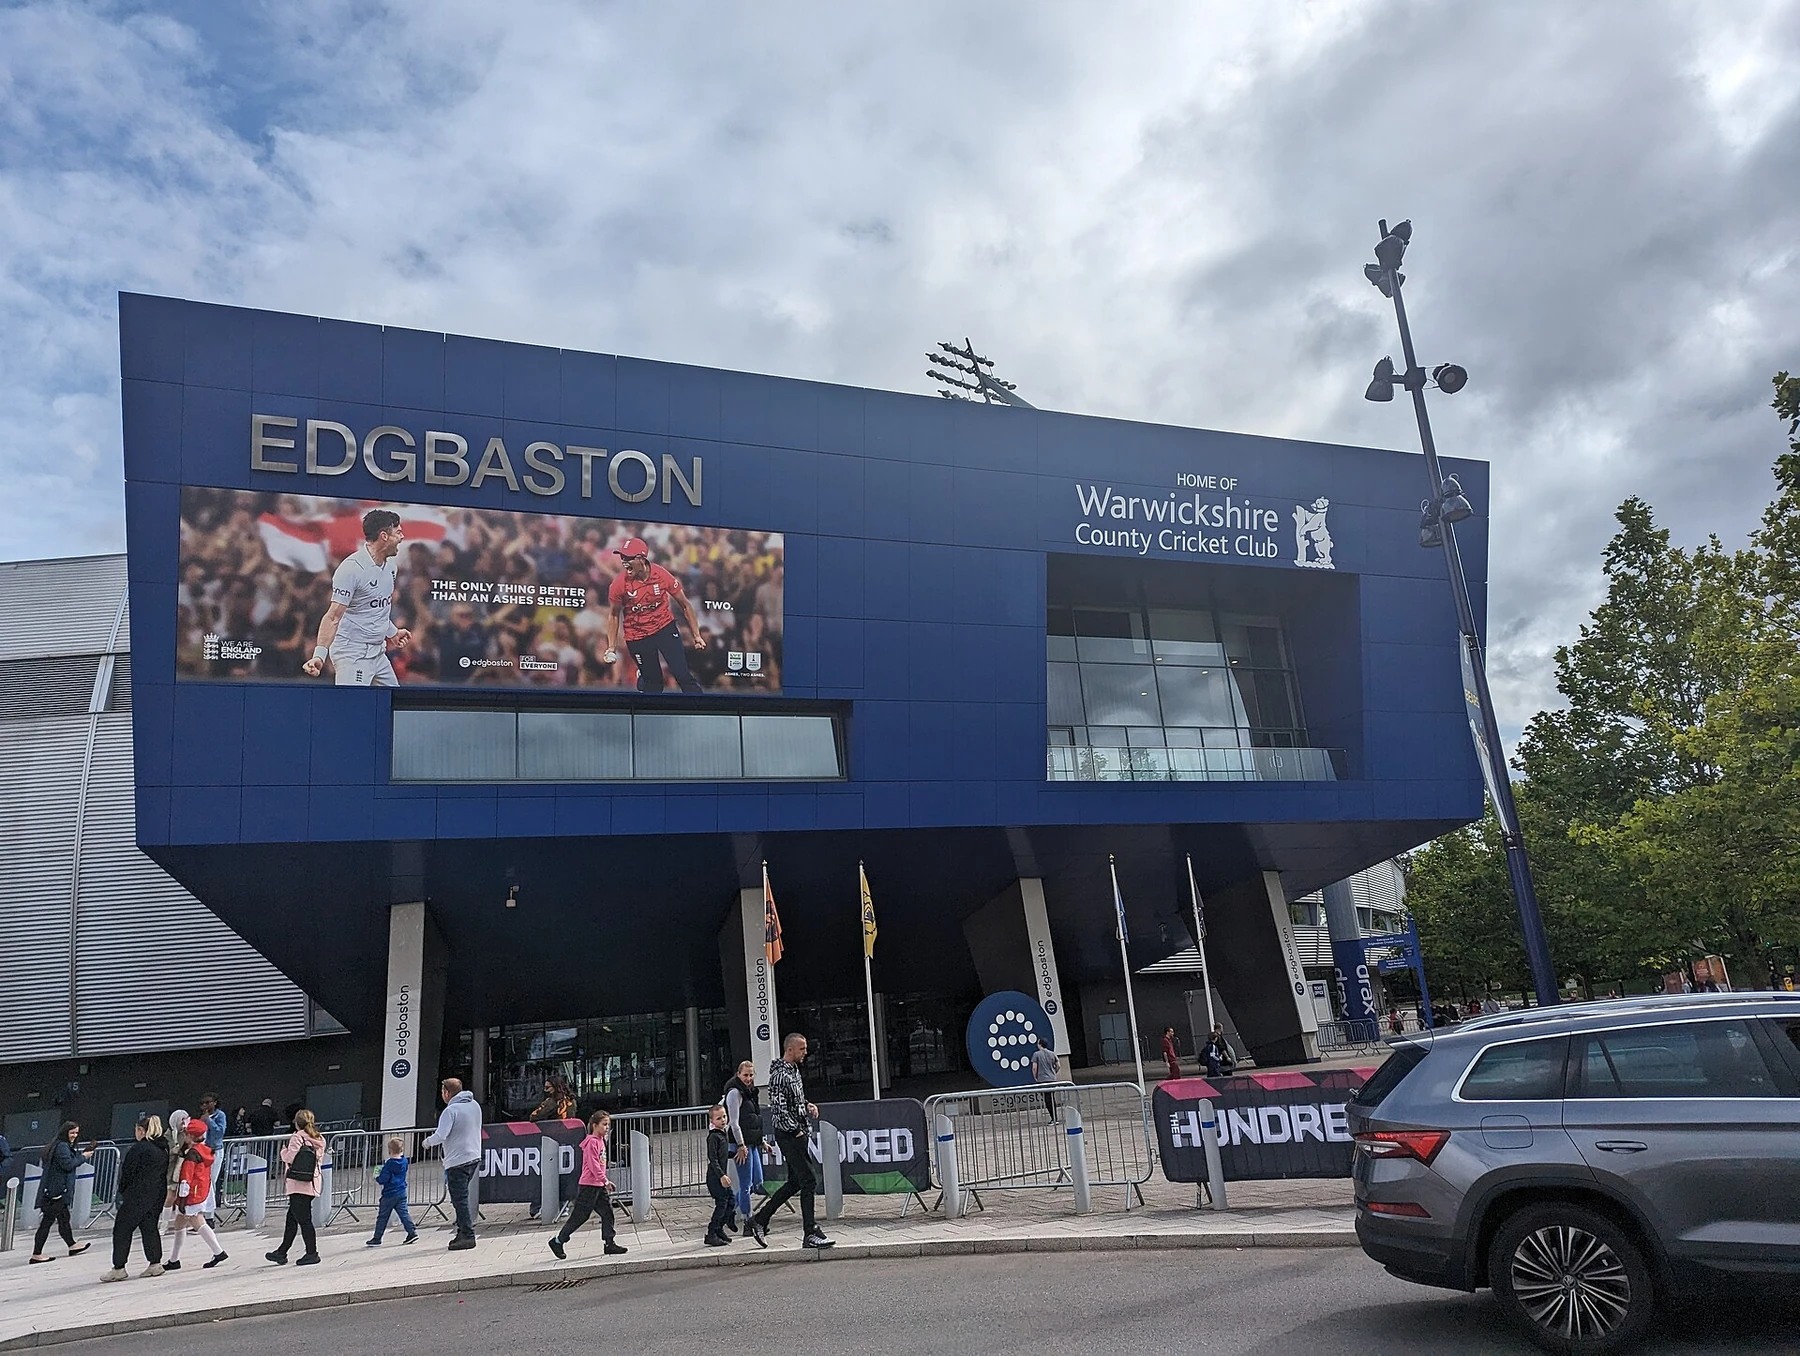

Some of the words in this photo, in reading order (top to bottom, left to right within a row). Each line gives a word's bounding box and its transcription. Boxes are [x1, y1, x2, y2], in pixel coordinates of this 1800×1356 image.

[250, 413, 702, 507] EDGBASTON
[1177, 472, 1217, 489] HOME
[1219, 477, 1238, 490] OF
[1075, 484, 1279, 532] Warwickshire
[1075, 522, 1152, 555] County
[1158, 529, 1229, 554] Cricket
[1234, 535, 1278, 558] Club
[431, 580, 457, 590] THE
[460, 581, 494, 592] ONLY
[497, 583, 536, 594] THING
[539, 586, 586, 597] BETTER
[430, 591, 467, 602] THAN
[470, 593, 489, 602] AN
[492, 594, 534, 605] ASHES
[537, 597, 586, 608] SERIES?
[704, 600, 734, 611] TWO.
[221, 646, 262, 654] ENGLAND
[221, 652, 257, 660] CRICKET
[472, 658, 514, 668] edgbaston
[520, 662, 556, 670] EVERYONE
[1282, 928, 1299, 980] edgbaston
[1037, 940, 1053, 997] edgbaston
[755, 958, 768, 1021] edgbaston
[395, 985, 410, 1056] edgbaston
[1169, 1113, 1181, 1134] THE
